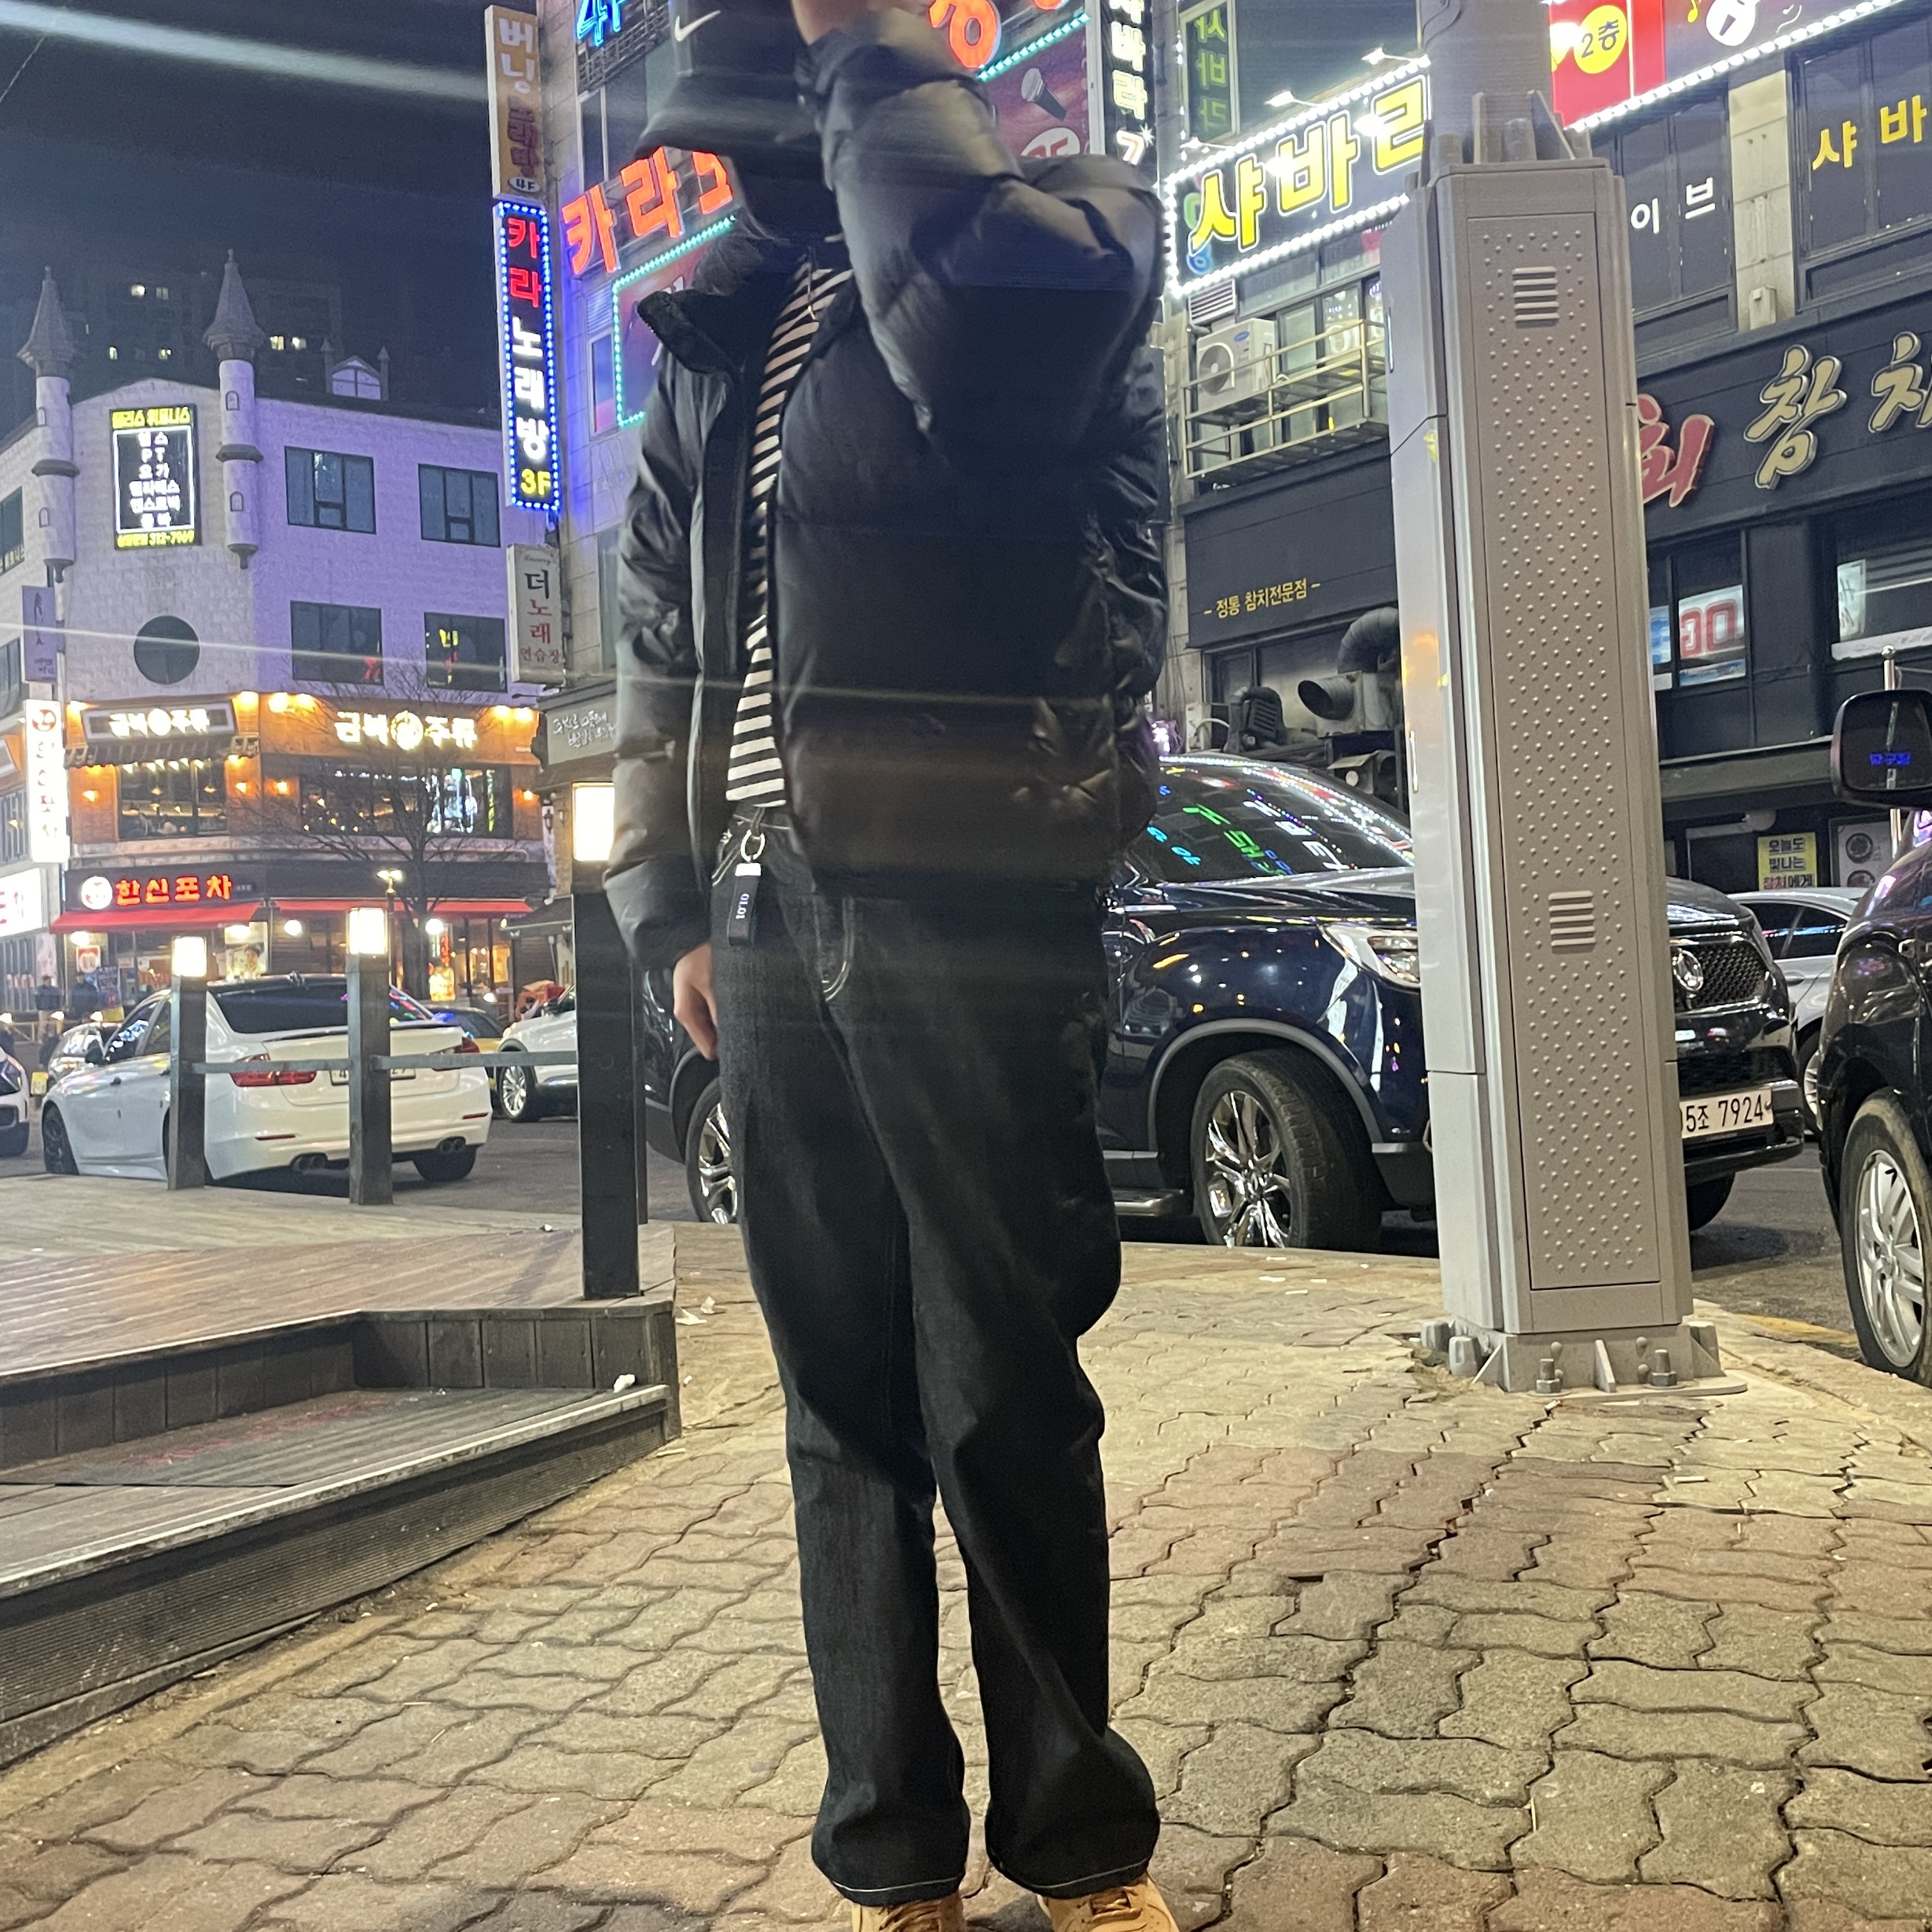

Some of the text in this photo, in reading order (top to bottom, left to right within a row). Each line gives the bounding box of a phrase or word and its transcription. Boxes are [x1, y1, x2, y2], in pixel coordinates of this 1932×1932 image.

[499, 17, 535, 94] 버닝
[1581, 19, 1620, 59] 2층
[516, 178, 536, 190] 4F
[1630, 177, 1716, 234] 이브
[507, 216, 552, 496] 카라 노래방 3F
[139, 463, 170, 480] 요가
[141, 447, 165, 463] PT
[524, 568, 549, 599] 더
[1216, 578, 1308, 619] 정통 참치전문점
[528, 599, 552, 645] 노래
[521, 646, 560, 664] 연습장
[115, 874, 232, 907] 한신포차
[1680, 1093, 1764, 1133] 5조 7924
